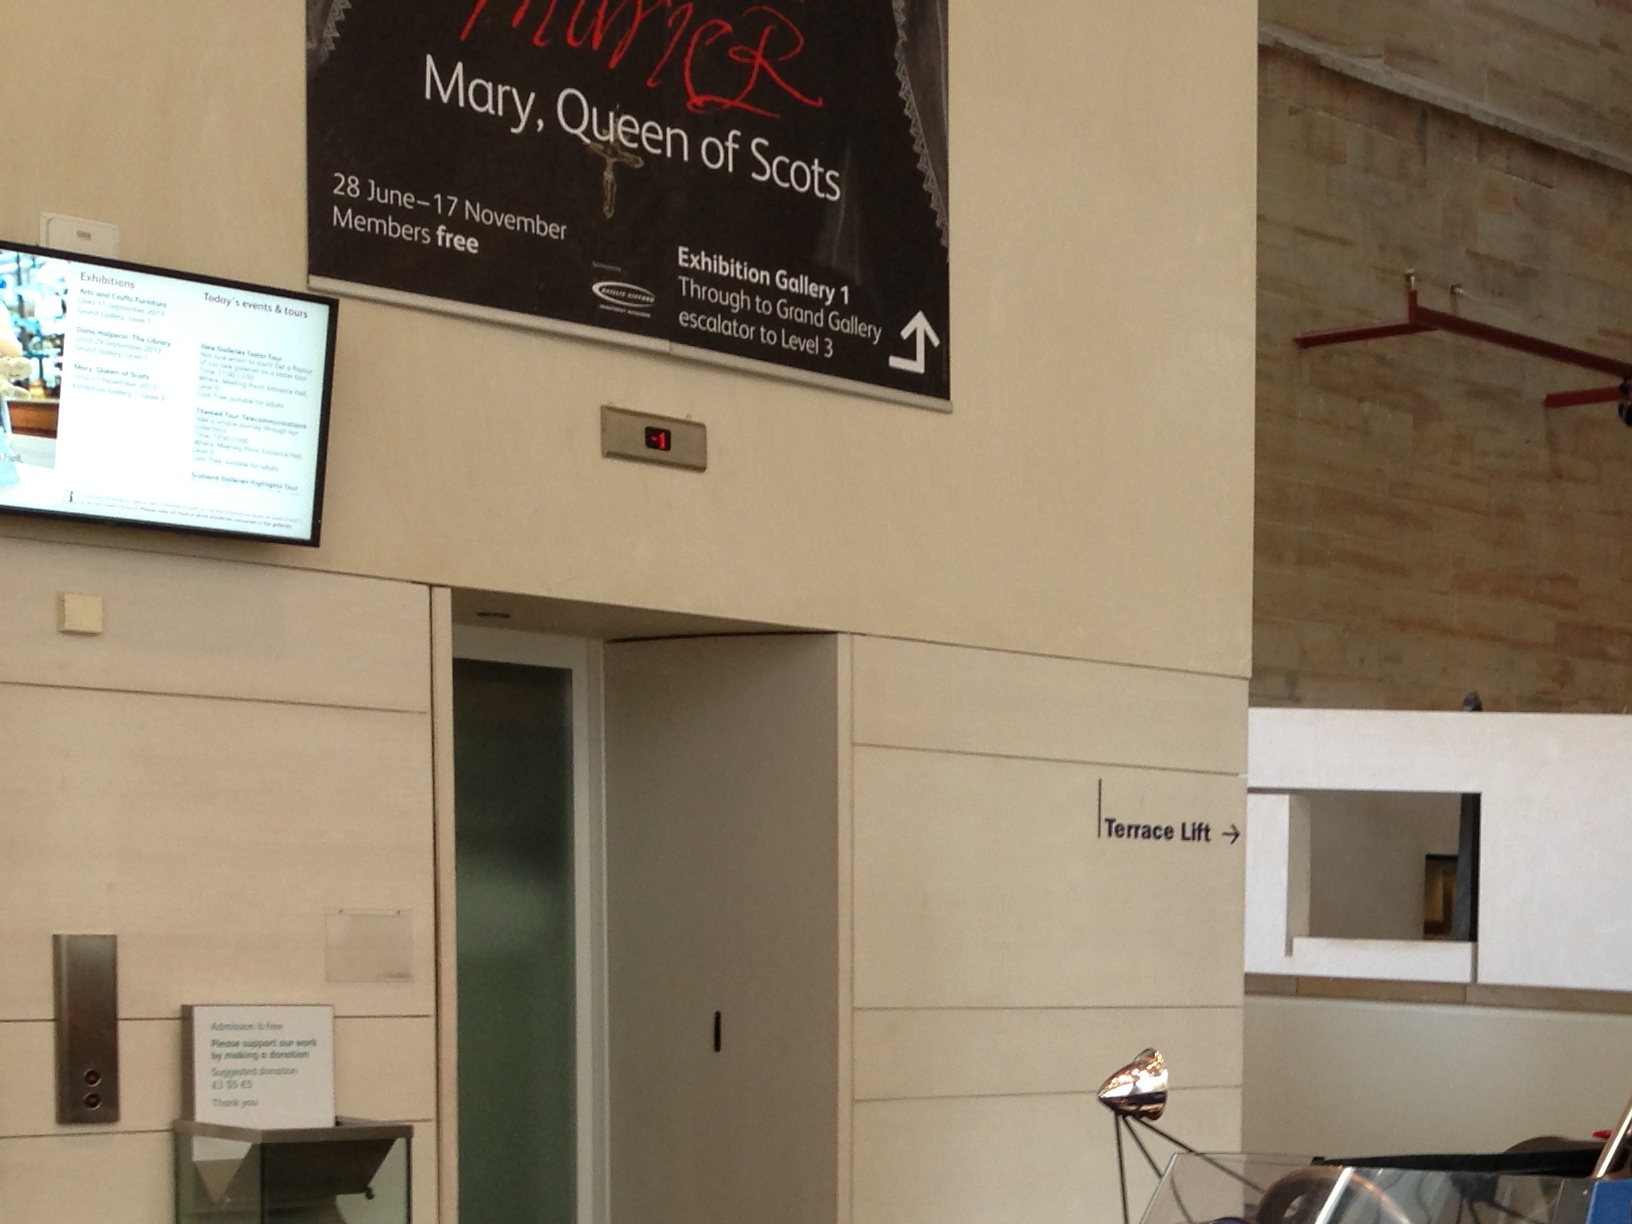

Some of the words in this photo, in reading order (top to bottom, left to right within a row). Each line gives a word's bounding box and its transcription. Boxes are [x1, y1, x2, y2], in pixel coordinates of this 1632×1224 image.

[424, 54, 544, 133] Mary,
[557, 88, 689, 162] Queen
[701, 130, 741, 172] of
[752, 138, 841, 201] Scots
[333, 172, 360, 198] 28
[465, 200, 567, 240] November
[333, 205, 431, 245] Members
[436, 225, 479, 253] free
[81, 272, 135, 289] Exhibitions
[678, 246, 770, 286] Exhibition
[775, 269, 835, 304] Gallery
[840, 285, 850, 304] 1
[96, 290, 110, 298] and
[204, 292, 240, 307] Today's
[242, 300, 272, 313] events
[275, 304, 282, 314] &
[284, 307, 308, 319] tours
[678, 276, 750, 314] Through
[756, 294, 772, 315] to
[777, 299, 824, 328] Grand
[828, 311, 882, 345] Gallery
[678, 311, 758, 340] escalator
[760, 322, 777, 344] to
[781, 329, 820, 355] Level
[824, 337, 834, 358] 3
[1105, 818, 1174, 840] Terrace
[1181, 822, 1211, 842] Lift
[211, 1022, 253, 1031] Admission
[211, 1039, 239, 1048] Please
[243, 1039, 276, 1049] support
[296, 1038, 317, 1047] work
[211, 1052, 222, 1061] by
[224, 1052, 259, 1061] making
[269, 1050, 310, 1059] donation
[211, 1067, 257, 1078] Suggested
[260, 1067, 298, 1075] donation
[211, 1099, 239, 1107] Thank
[242, 1099, 257, 1109] you
